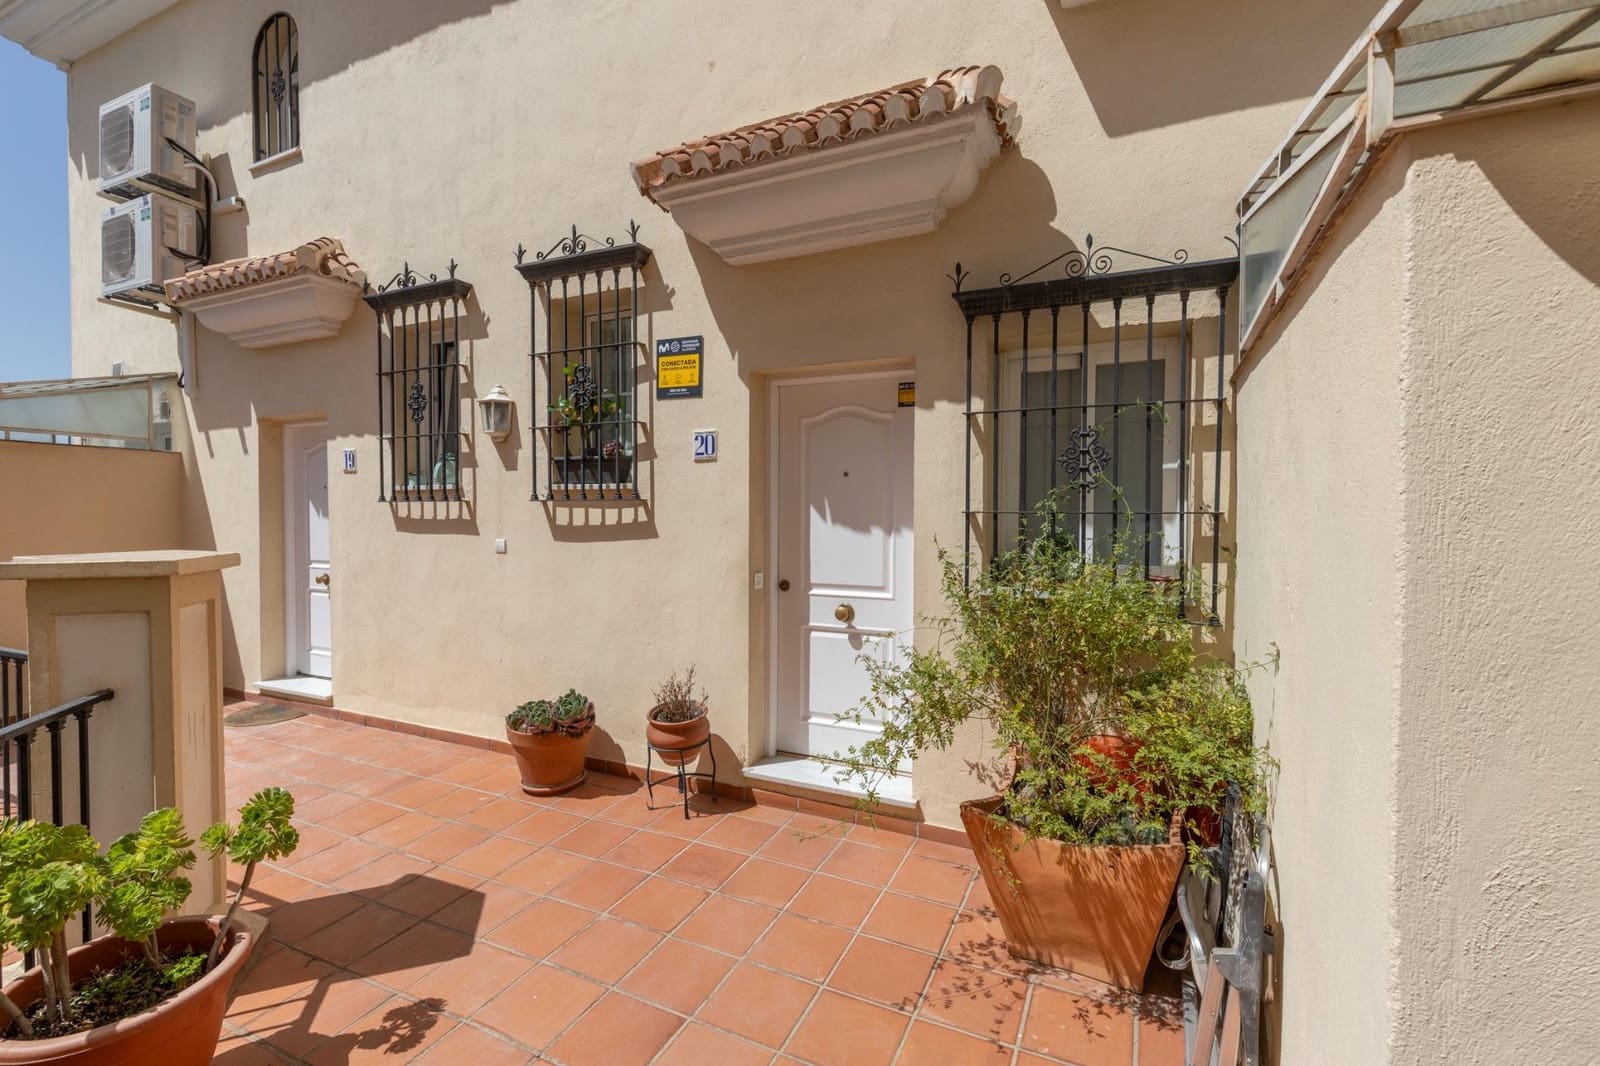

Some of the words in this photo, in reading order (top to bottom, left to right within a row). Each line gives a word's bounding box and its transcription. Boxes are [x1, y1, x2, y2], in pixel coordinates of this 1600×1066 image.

[661, 359, 697, 367] CONECTADA
[694, 434, 715, 456] 20
[345, 452, 355, 468] 19
